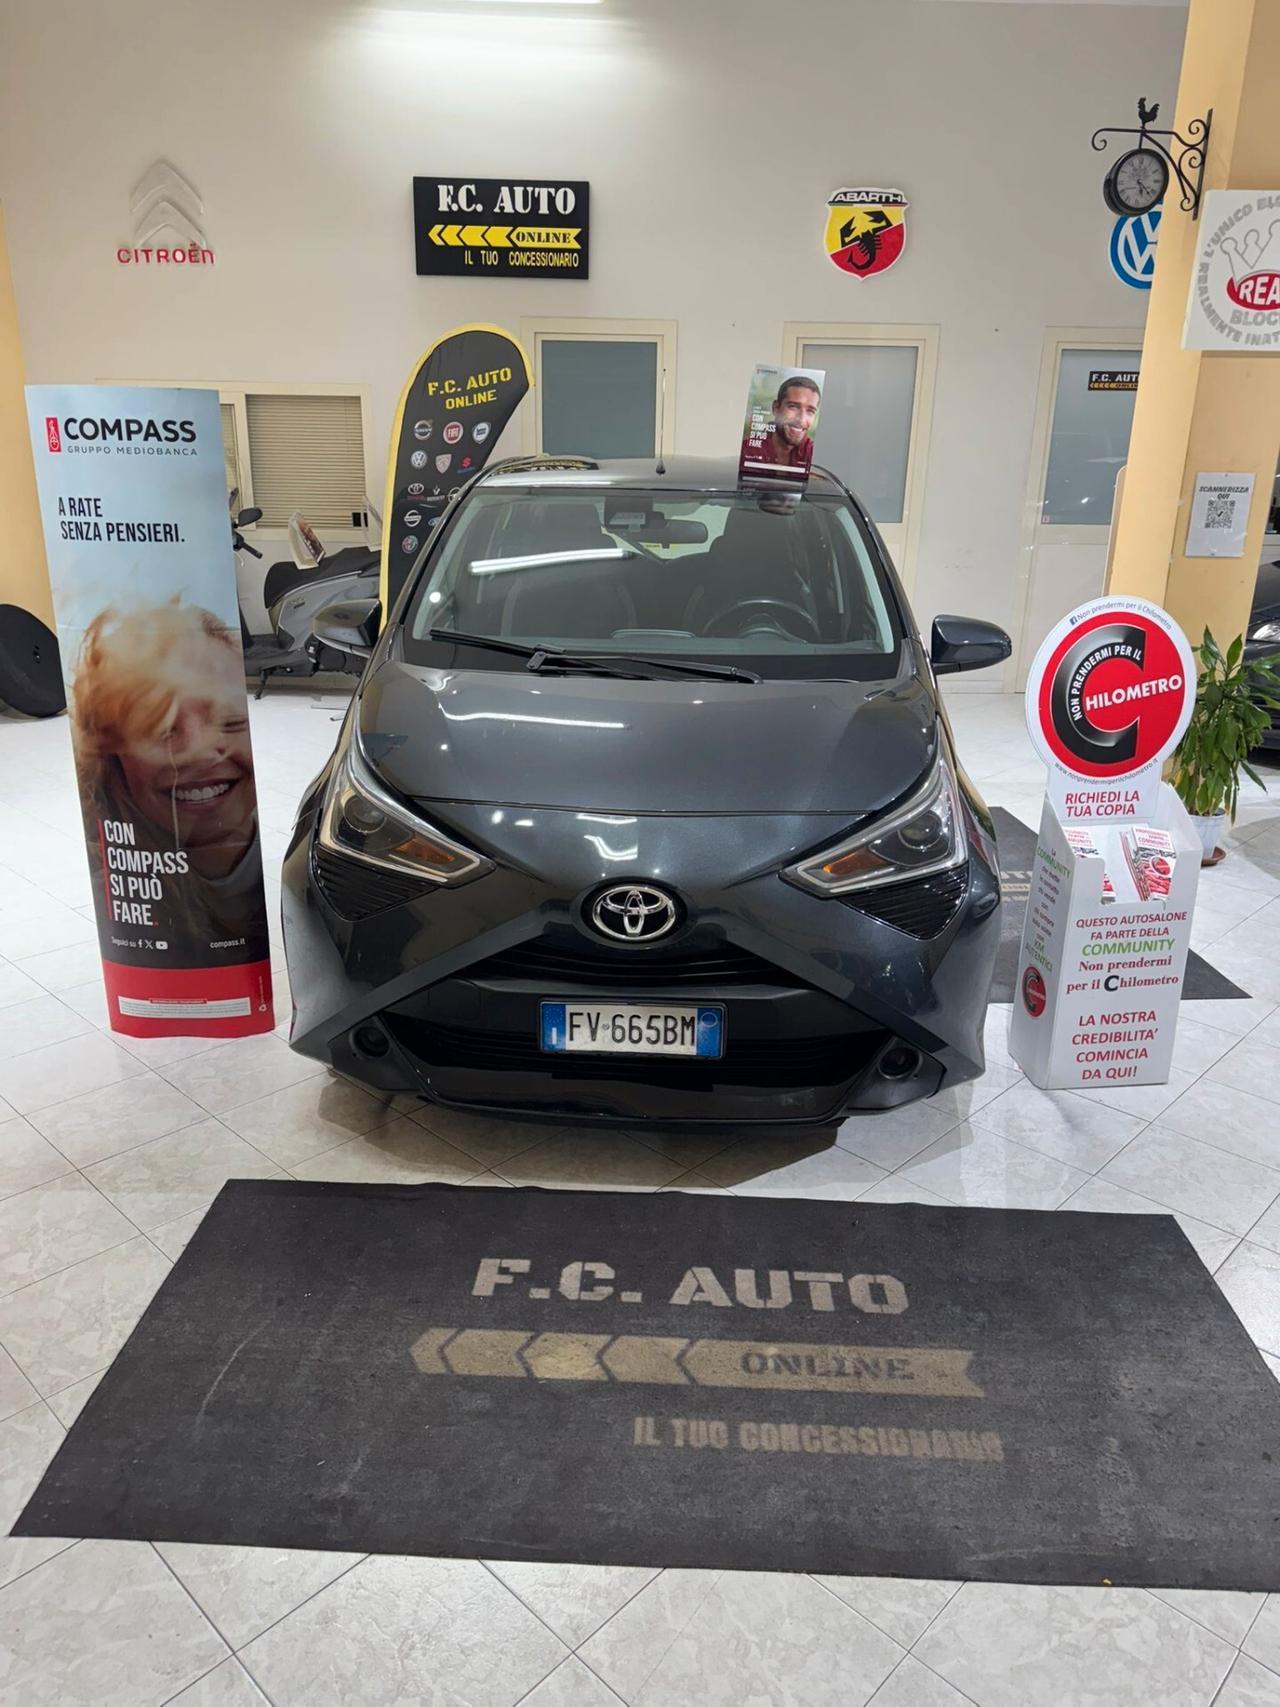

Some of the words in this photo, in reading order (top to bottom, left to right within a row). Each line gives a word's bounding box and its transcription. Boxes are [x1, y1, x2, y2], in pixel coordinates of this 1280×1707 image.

[438, 184, 483, 212] F.C.
[494, 186, 576, 215] AUTO
[834, 192, 902, 202] ABARTH
[1257, 196, 1280, 211] BLO
[516, 232, 571, 244] ONLINE
[464, 251, 474, 265] IL
[481, 251, 499, 266] TUO
[509, 252, 579, 267] CONCESSIONARIO
[1239, 275, 1280, 306] REA
[1197, 262, 1243, 343] REALMENTE
[1244, 331, 1280, 346] INAT
[1230, 309, 1280, 327] BLOC
[428, 379, 462, 396] F.C.
[466, 367, 512, 390] AUTO
[1092, 373, 1111, 382] F.C.
[1115, 373, 1138, 382] AUT
[445, 389, 497, 410] ONLINE
[64, 418, 197, 443] COMPASS
[66, 445, 112, 455] GRUPPO
[117, 447, 199, 457] MEDIOBANCA
[58, 497, 66, 516] A
[69, 497, 103, 517] RATE
[61, 521, 102, 541] SENZA
[106, 523, 185, 543] PENSIERI.
[1114, 645, 1133, 657] PER
[1133, 648, 1142, 661] IL
[1071, 646, 1112, 695] PRENDERMI
[1070, 698, 1082, 721] NON
[1065, 790, 1121, 805] RICHIEDI
[1124, 790, 1140, 802] LA
[1066, 805, 1092, 818] TUA
[1096, 803, 1136, 816] COPIA
[104, 820, 135, 846] CON
[107, 847, 189, 874] COMPASS
[110, 874, 125, 898] SI
[128, 873, 163, 900] PUÒ
[1076, 916, 1117, 928] QUESTO
[1120, 911, 1187, 926] AUTOSALONE
[1090, 932, 1103, 941] FA
[1105, 929, 1136, 941] PARTE
[1138, 928, 1169, 939] DELLA
[1081, 938, 1176, 957] COMMUNITY
[1078, 961, 1103, 972] Non
[1107, 956, 1172, 973] prendermi
[1066, 981, 1088, 994] per
[1090, 978, 1101, 990] il
[1103, 974, 1179, 992] Chilometro
[1078, 1015, 1097, 1027] LA
[1100, 1010, 1157, 1025] NOSTRA
[1076, 1048, 1149, 1063] COMINCIA
[1081, 1068, 1102, 1080] DA
[1106, 1066, 1137, 1080] QUI!
[472, 1257, 643, 1303] F.C.
[669, 1266, 911, 1314] AUTO
[740, 1351, 915, 1382] ONLINE
[633, 1416, 661, 1447] IL
[671, 1417, 729, 1450] TUO
